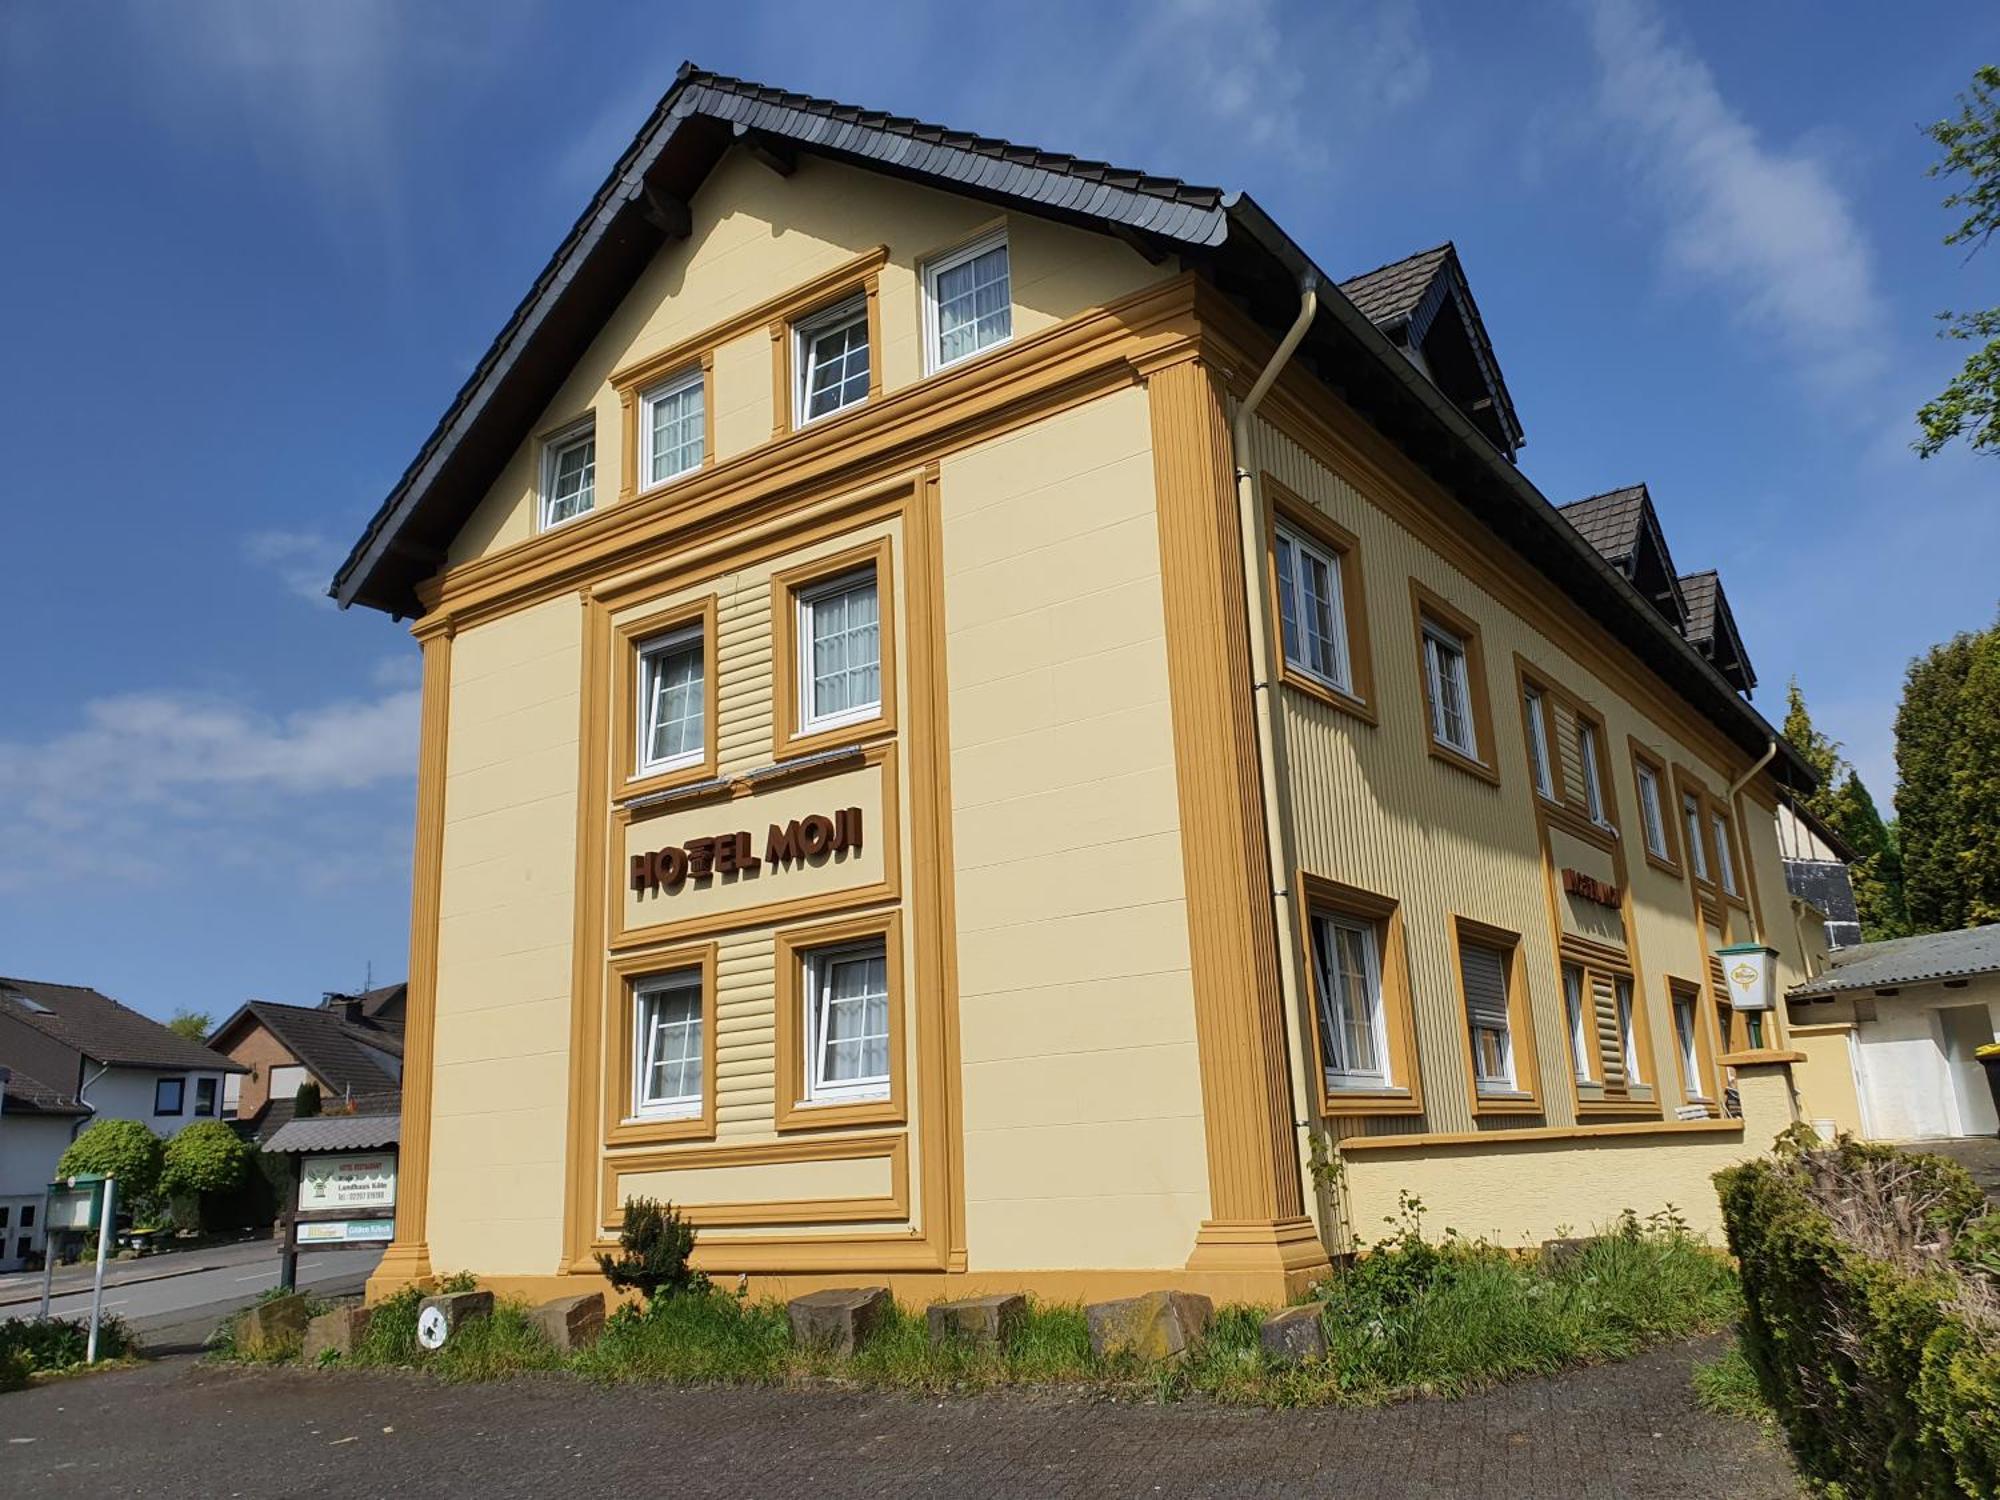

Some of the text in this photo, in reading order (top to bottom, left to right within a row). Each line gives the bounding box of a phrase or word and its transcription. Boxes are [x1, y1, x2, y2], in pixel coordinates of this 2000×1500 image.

[630, 807, 863, 890] HOTEL MOJI
[338, 1182, 370, 1192] Landhaus
